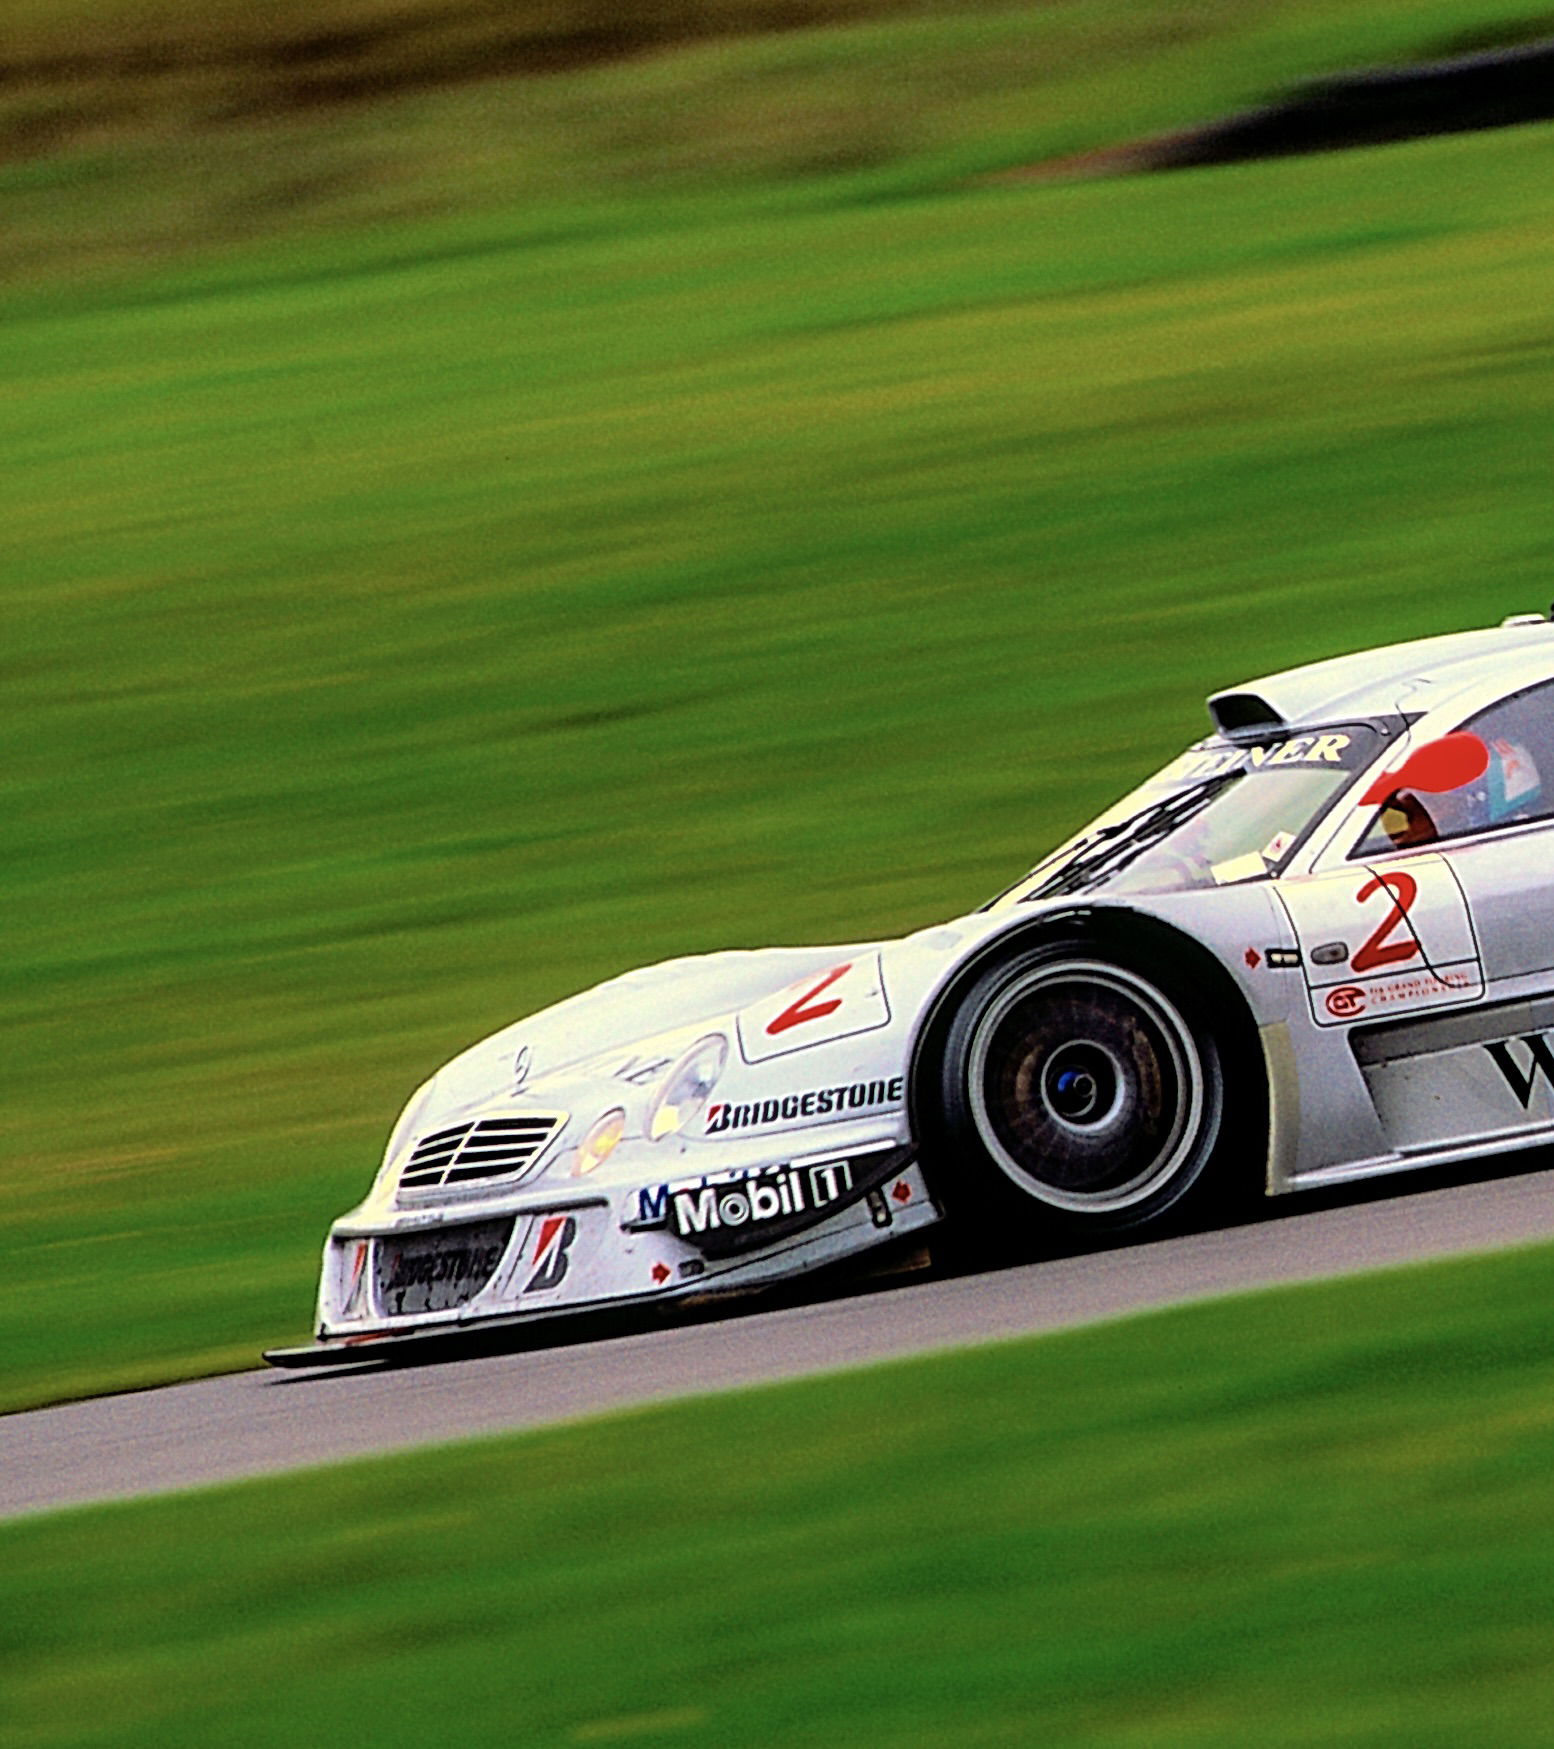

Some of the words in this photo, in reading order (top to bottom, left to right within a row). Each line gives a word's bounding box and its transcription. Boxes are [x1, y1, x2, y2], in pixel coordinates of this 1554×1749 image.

[1350, 872, 1421, 973] 2
[765, 963, 853, 1036] 2
[704, 1076, 904, 1135] BRIDGESTONE
[673, 1170, 805, 1236] Mobil
